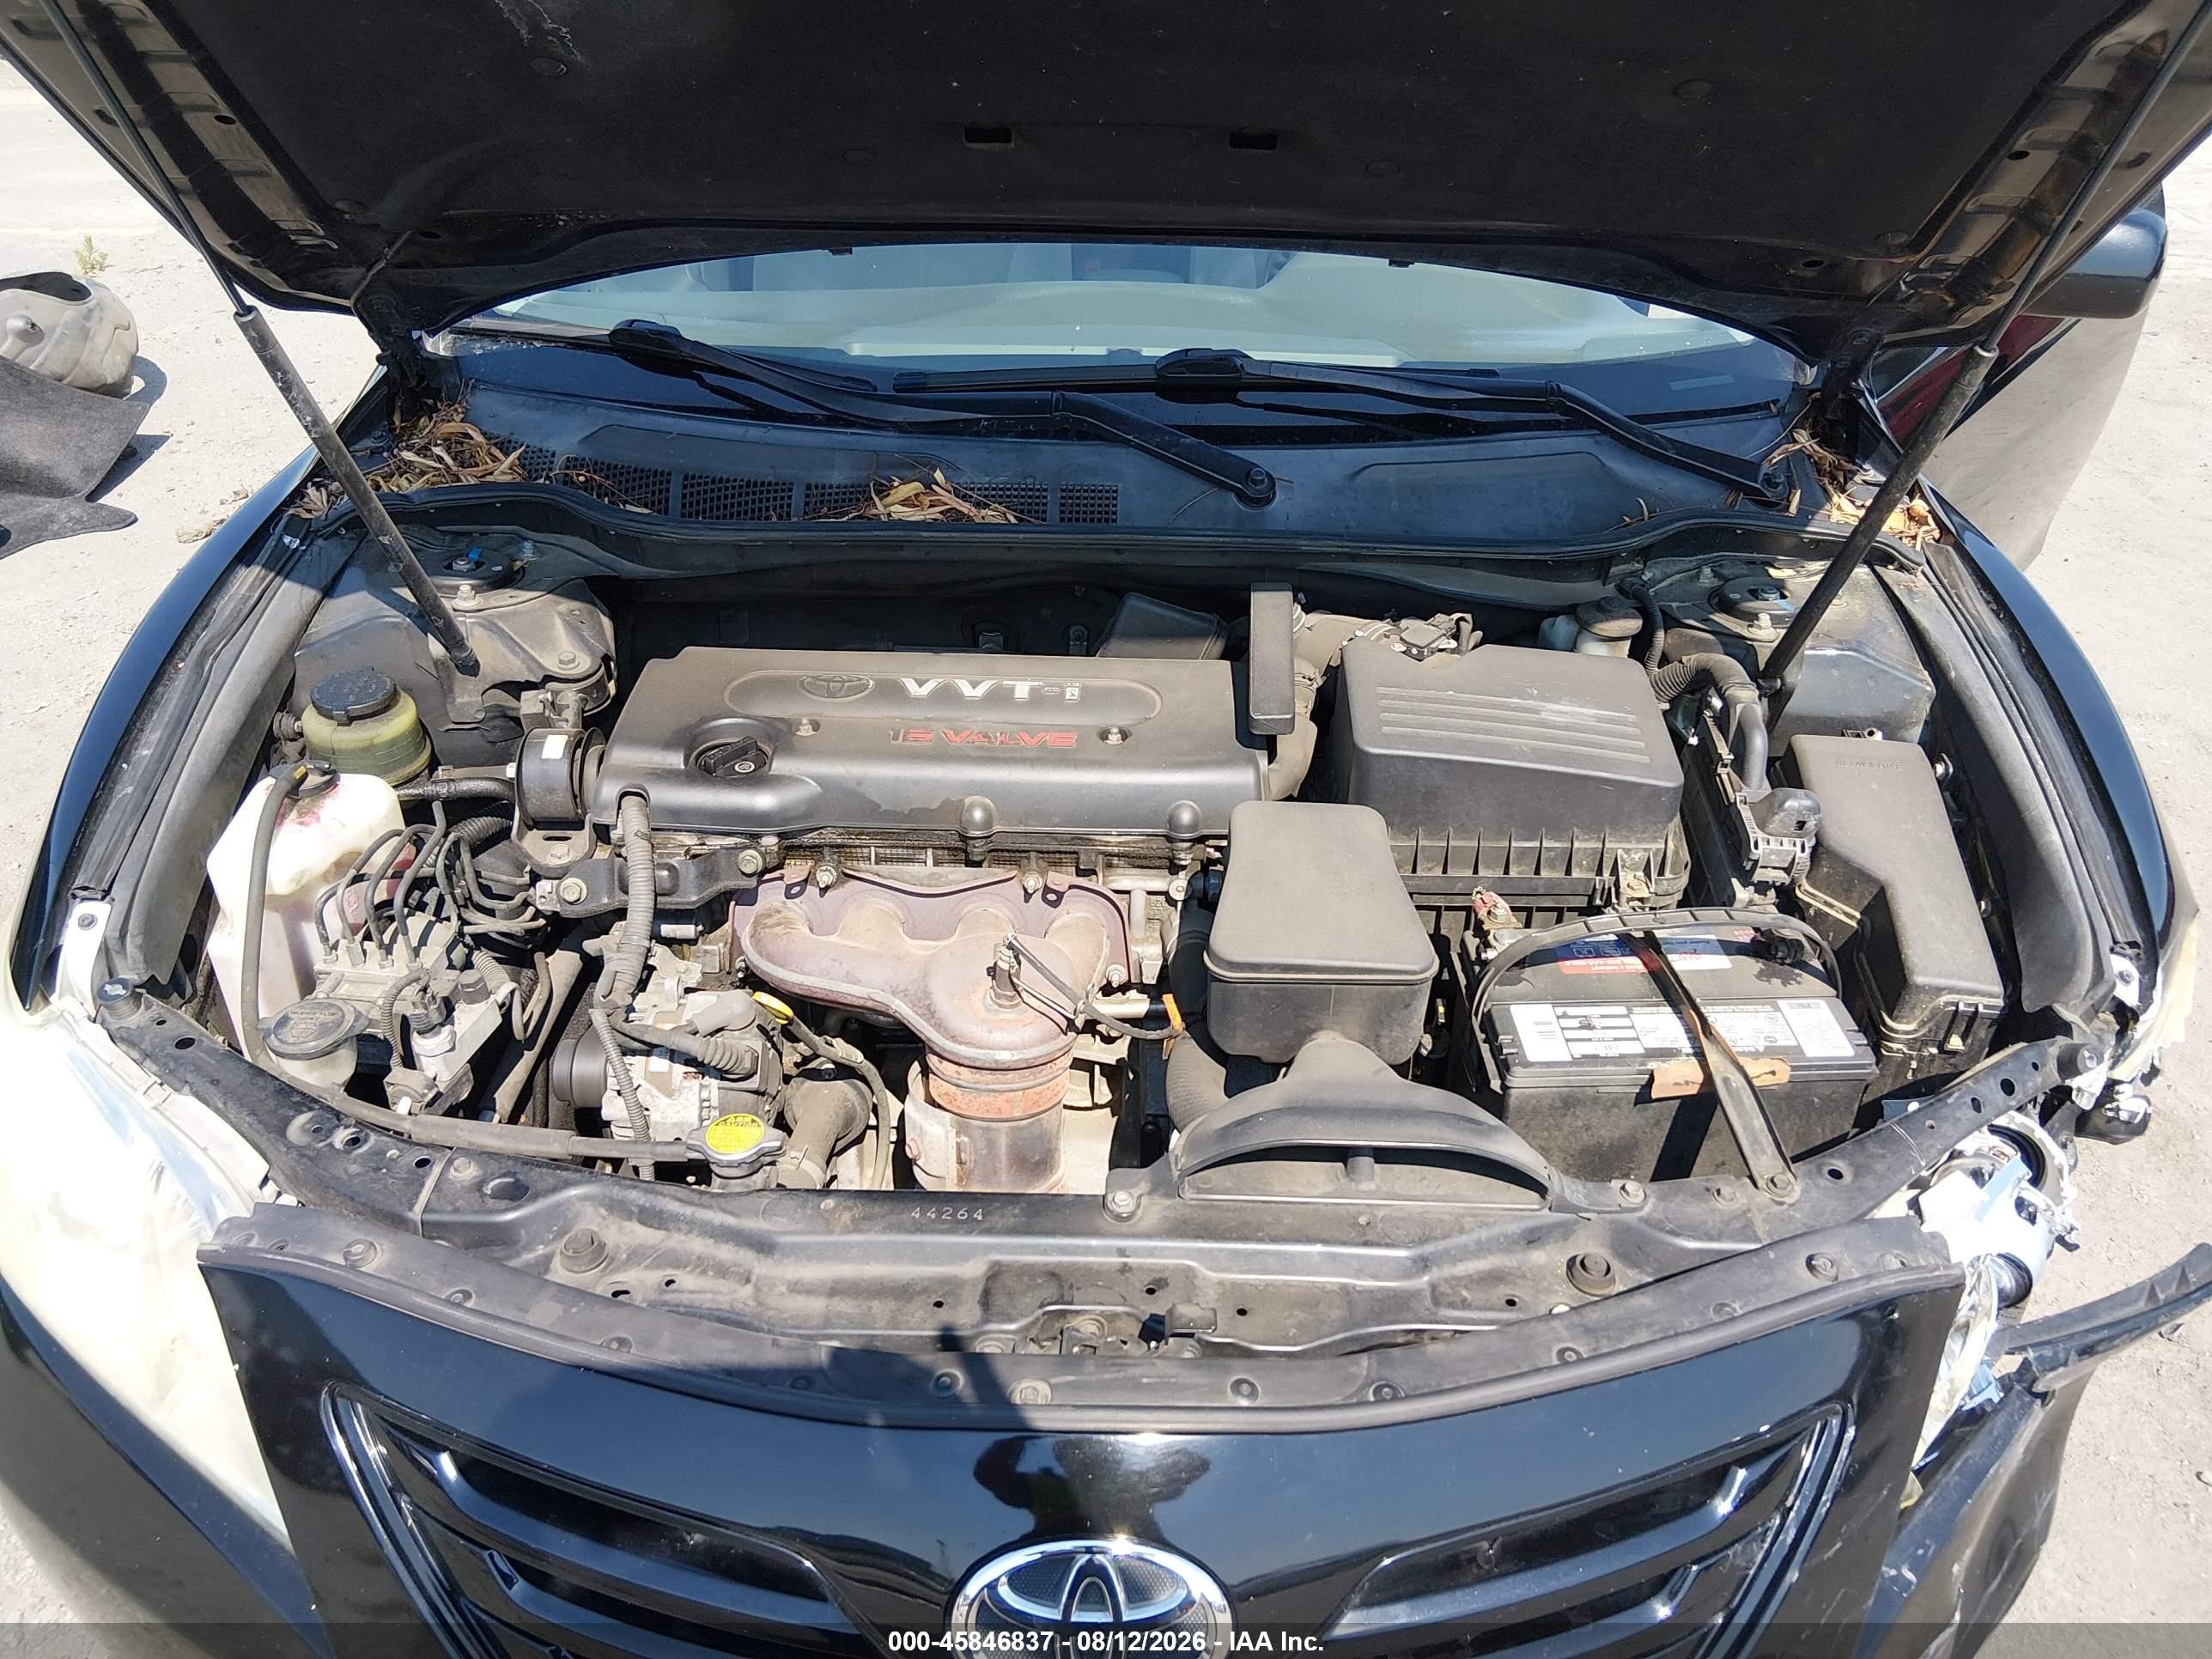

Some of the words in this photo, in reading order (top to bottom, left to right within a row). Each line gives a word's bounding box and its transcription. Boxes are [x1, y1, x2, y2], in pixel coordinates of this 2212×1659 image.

[899, 678, 1081, 702] VVT-i
[941, 728, 1078, 748] VALVE
[911, 1206, 983, 1220] 44264
